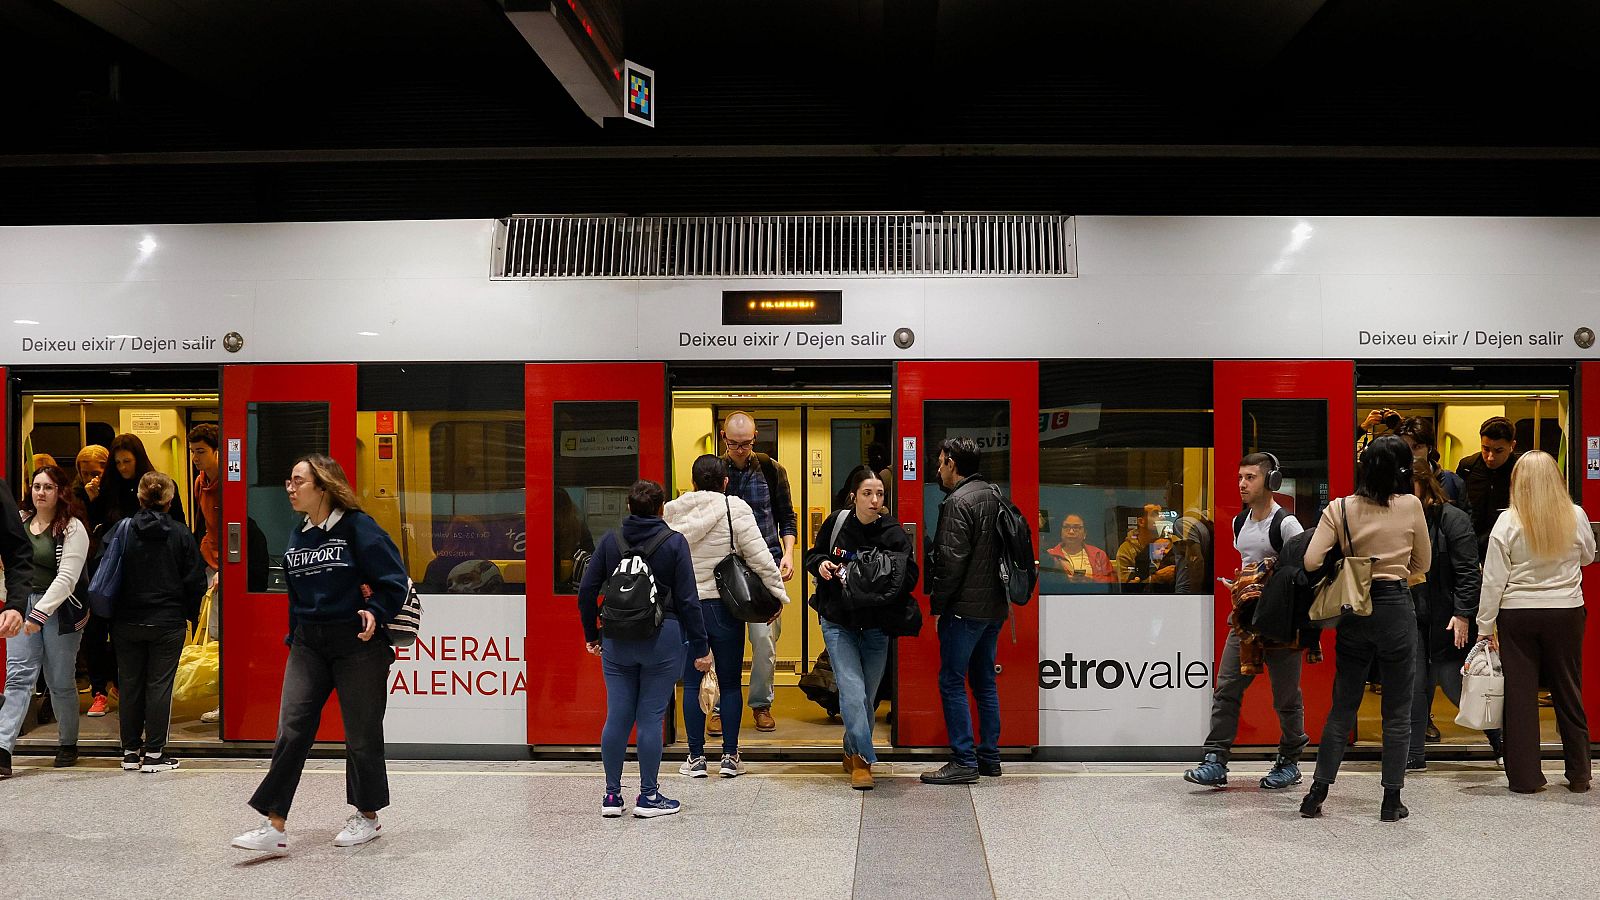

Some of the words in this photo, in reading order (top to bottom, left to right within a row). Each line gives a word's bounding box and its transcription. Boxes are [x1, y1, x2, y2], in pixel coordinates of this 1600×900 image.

[22, 337, 76, 351] Deixeu
[81, 337, 116, 351] eixir
[119, 337, 126, 351] /
[131, 337, 177, 354] Dejen
[182, 335, 217, 350] salir
[679, 332, 737, 347] Deixeu
[743, 331, 779, 346] eixir
[784, 331, 791, 347] /
[796, 331, 845, 349] Dejen
[850, 331, 887, 346] salir
[1359, 331, 1417, 346] Deixeu
[1422, 331, 1459, 345] eixir
[1463, 330, 1470, 346] /
[1475, 330, 1523, 349] Dejen
[1528, 330, 1564, 345] salir
[286, 546, 344, 569] NEWPORT
[388, 669, 528, 696] ALENCIA
